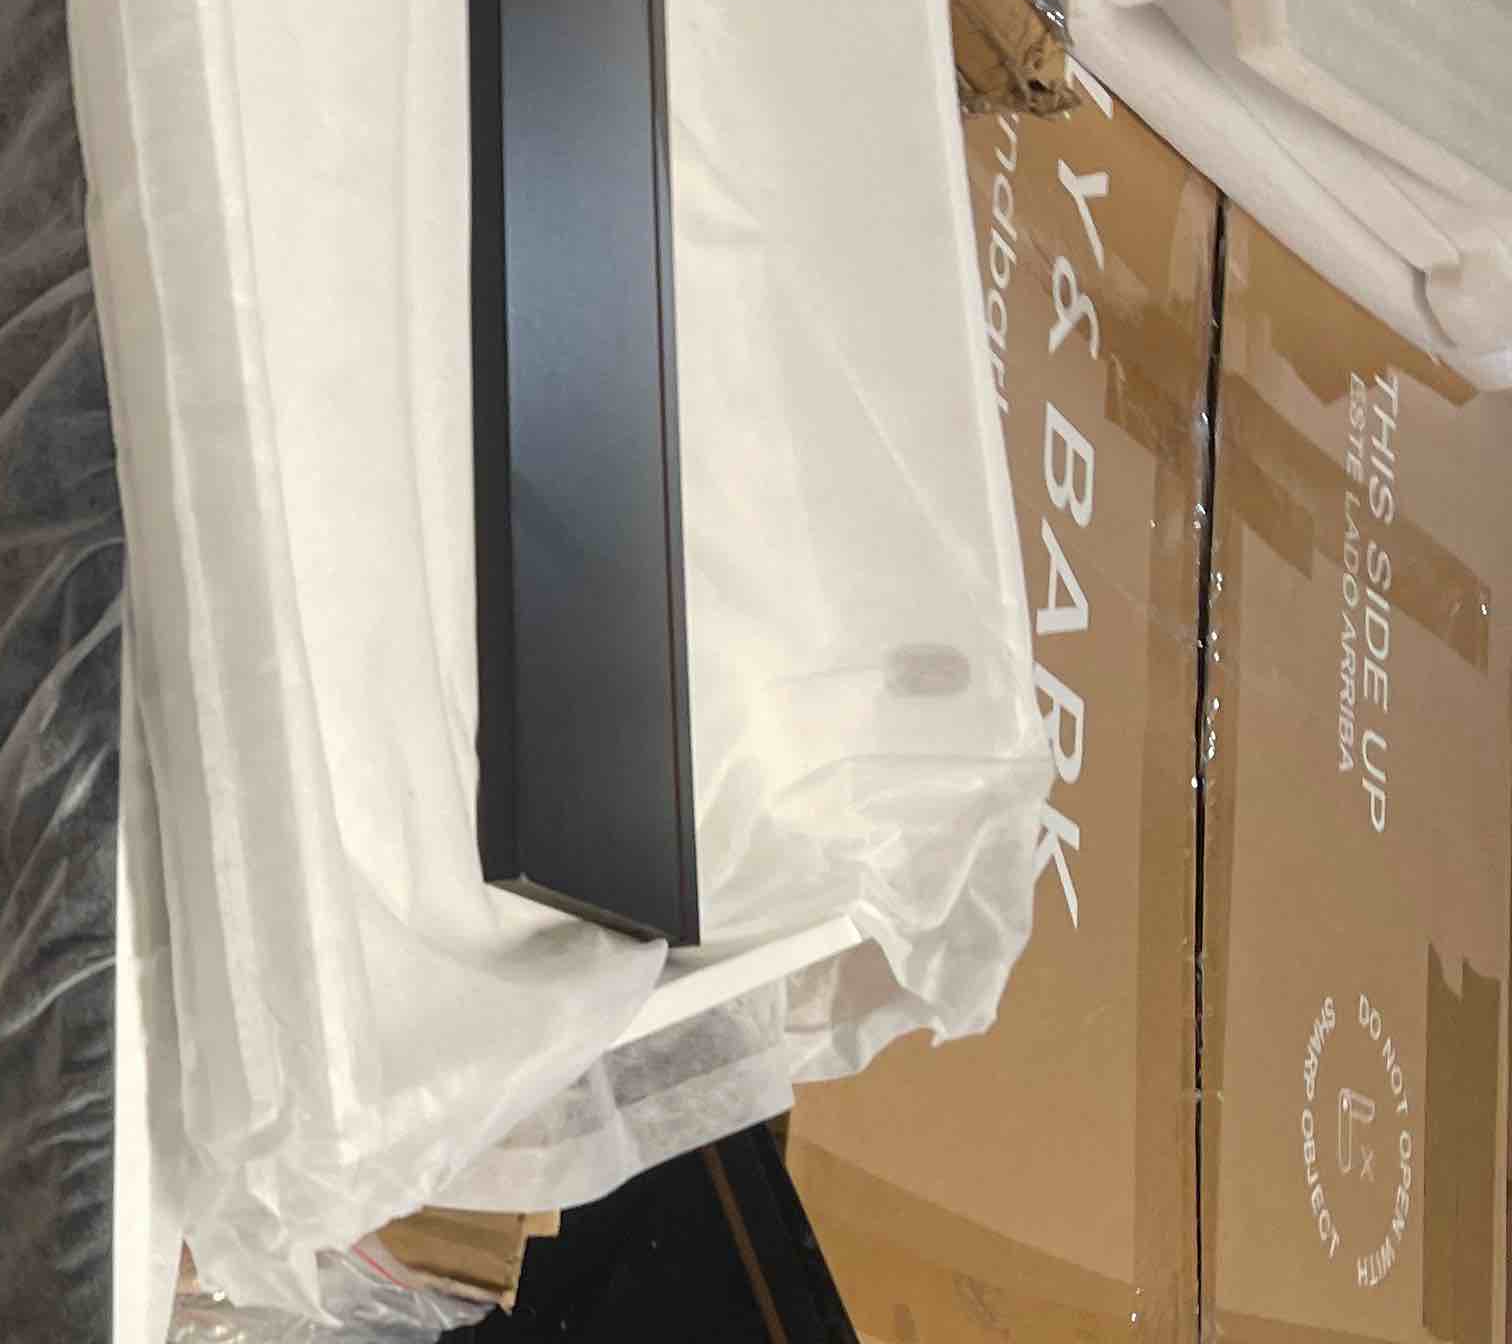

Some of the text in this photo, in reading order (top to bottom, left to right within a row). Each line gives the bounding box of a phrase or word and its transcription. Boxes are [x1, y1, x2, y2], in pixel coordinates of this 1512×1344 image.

[1033, 400, 1095, 929] BARK
[1338, 372, 1366, 772] ESTE LADO ARRIBA
[1361, 371, 1399, 833] THIS SIDE UP
[1301, 996, 1339, 1259] SHARP OBJECT
[1356, 993, 1412, 1287] DO NOT OPEN WITH
